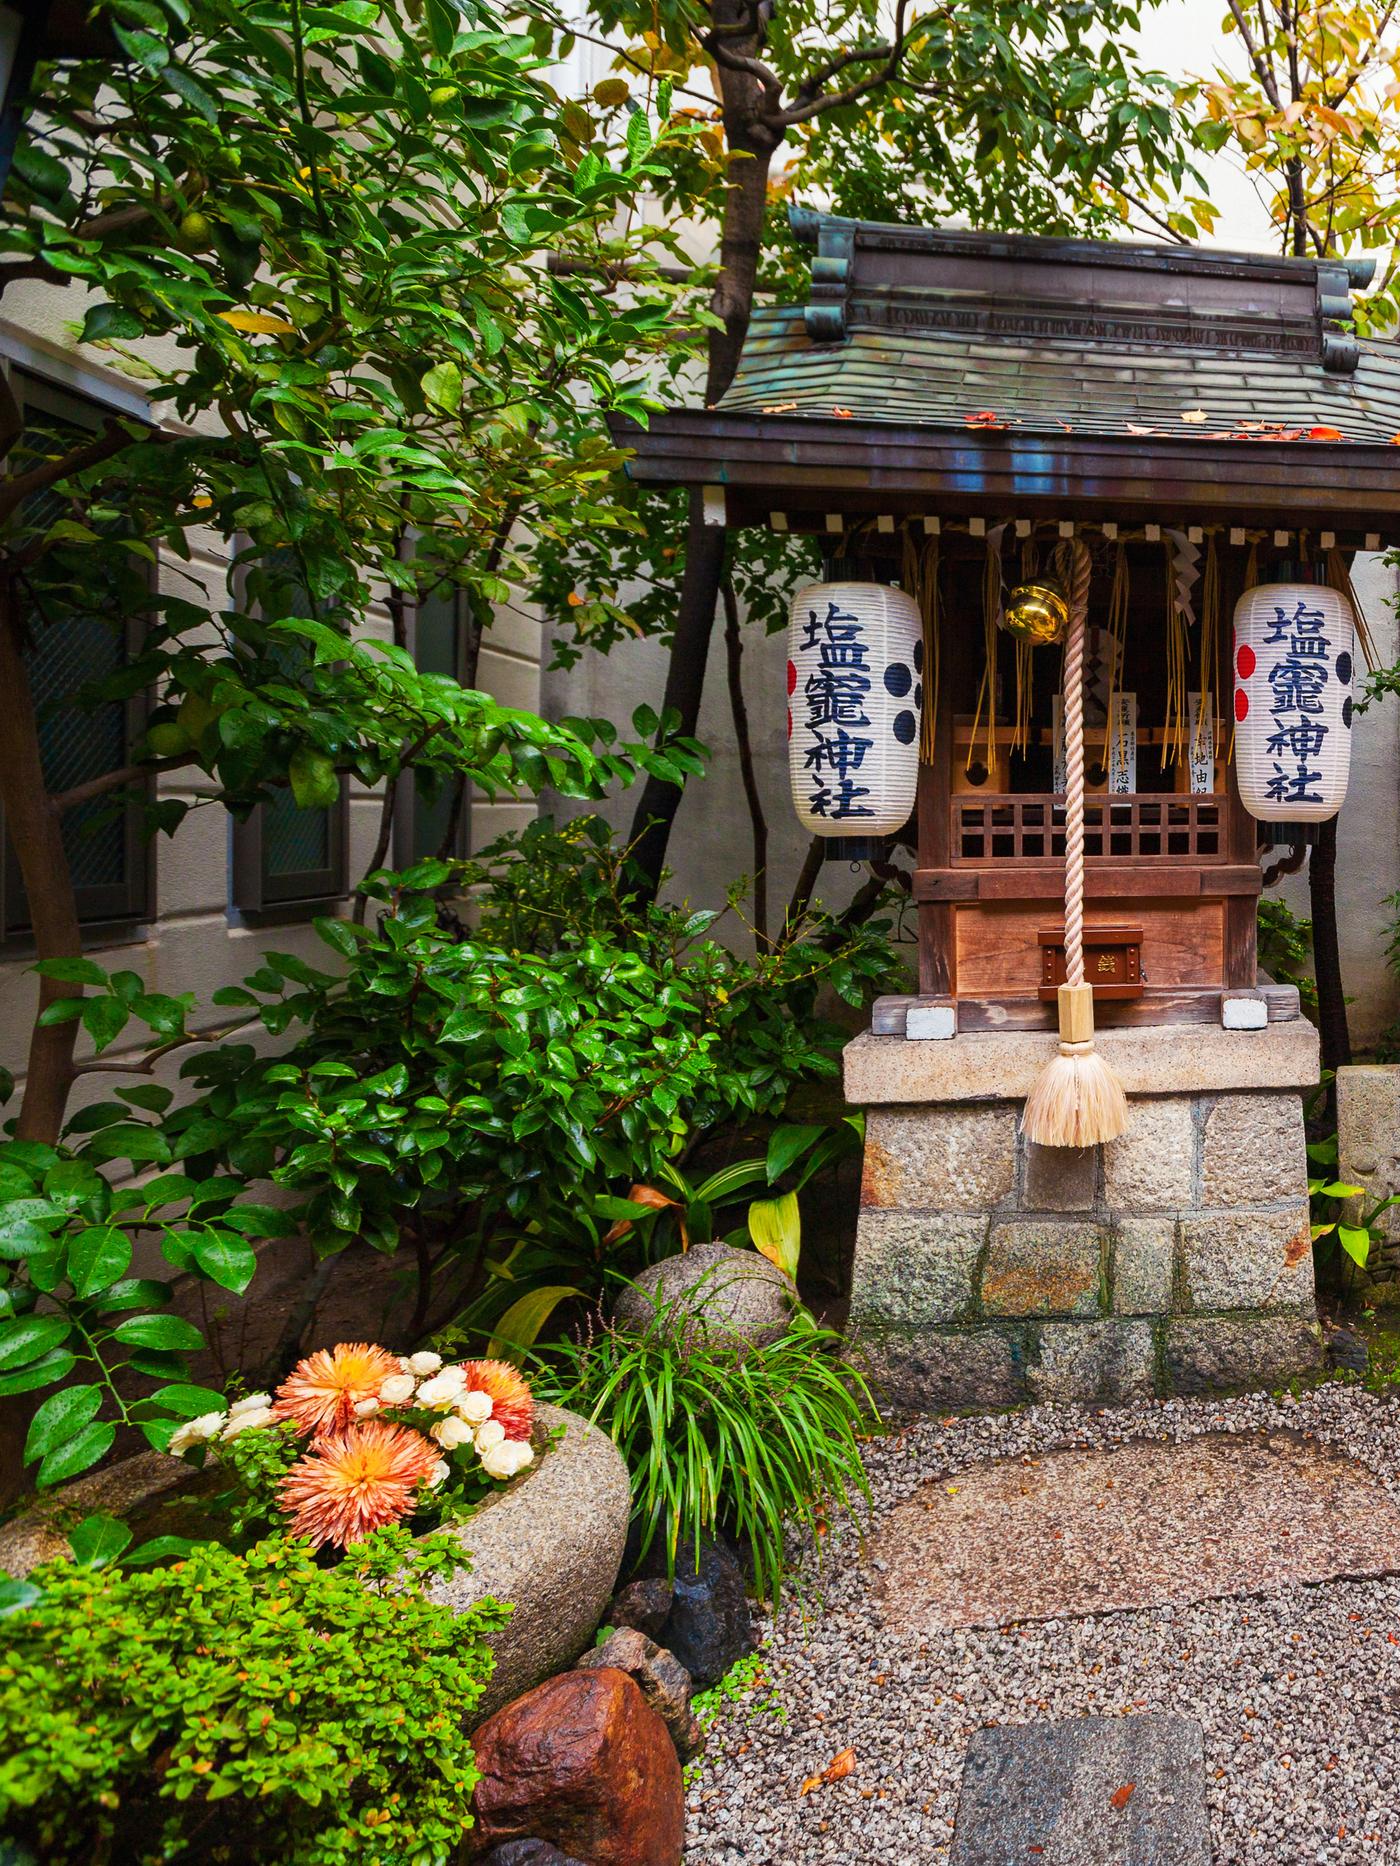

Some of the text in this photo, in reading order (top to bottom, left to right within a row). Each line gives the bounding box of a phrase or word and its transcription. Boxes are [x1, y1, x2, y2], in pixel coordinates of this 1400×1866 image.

[800, 602, 875, 819] 塩竈神社
[1263, 602, 1331, 803] 塩竈神社
